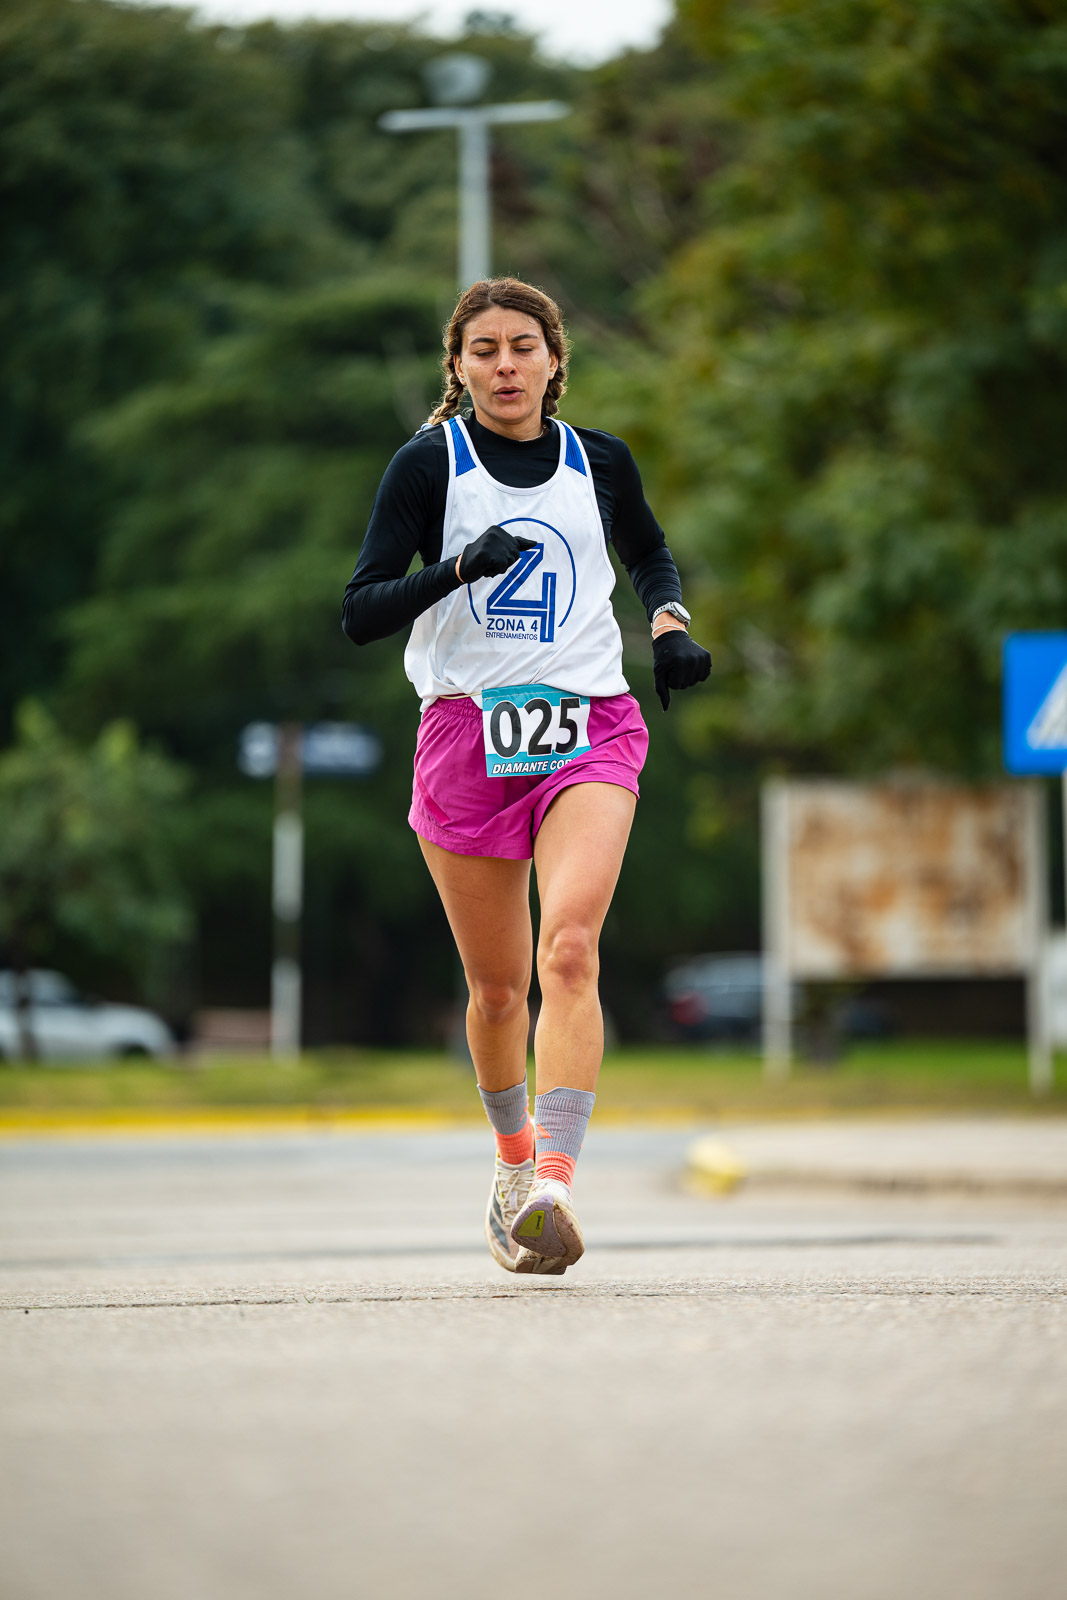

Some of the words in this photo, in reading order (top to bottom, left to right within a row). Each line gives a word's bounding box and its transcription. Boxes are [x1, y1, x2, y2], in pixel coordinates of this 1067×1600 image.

[486, 618, 525, 631] ZONA
[530, 619, 538, 632] 4
[485, 631, 538, 641] ENTRENAMIENTOS
[490, 697, 580, 759] 025
[492, 761, 548, 774] DIAMANTE
